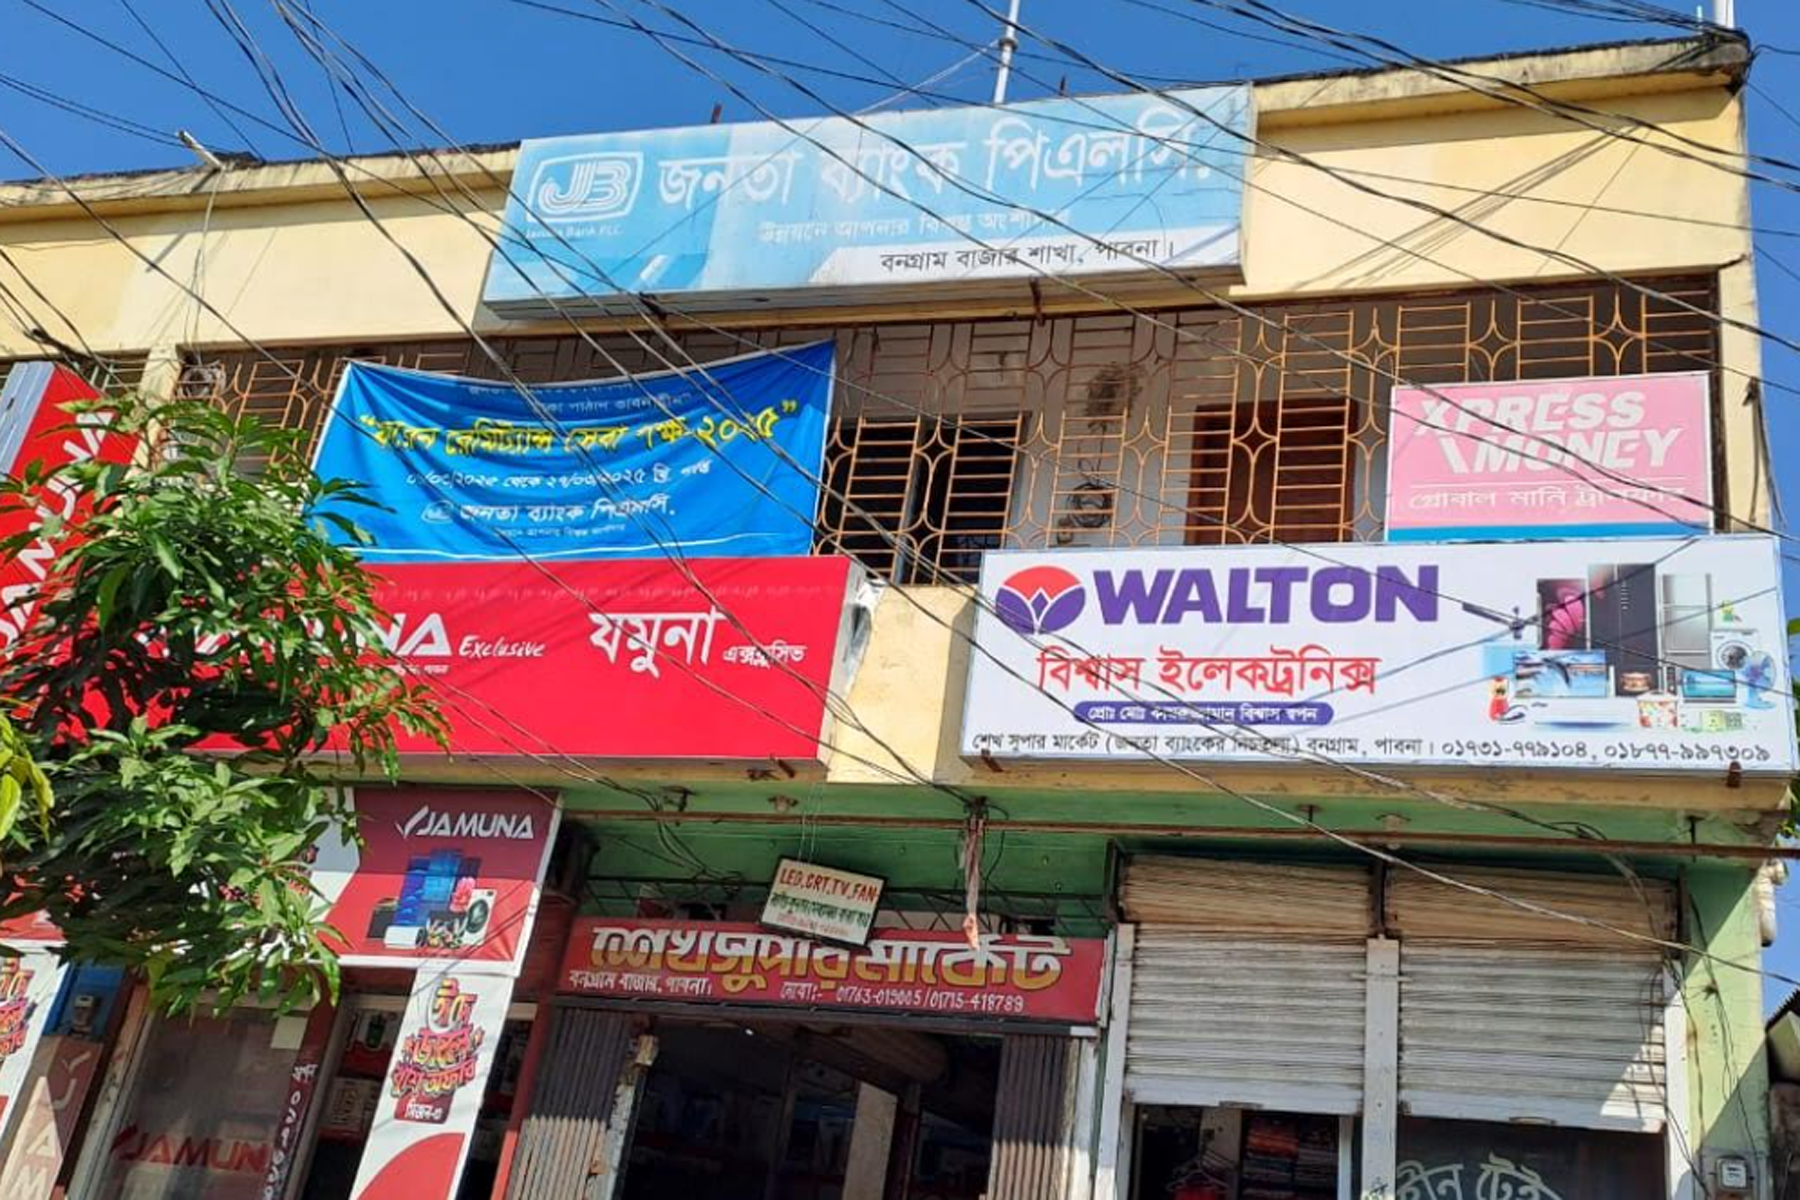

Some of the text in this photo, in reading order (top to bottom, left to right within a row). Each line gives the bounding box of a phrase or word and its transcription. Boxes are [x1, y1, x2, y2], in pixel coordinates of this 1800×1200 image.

[657, 150, 804, 211] জনতা
[880, 252, 949, 274] বনগ্রাম
[956, 247, 1020, 271] বাজার
[1473, 427, 1683, 473] MONEY
[1508, 484, 1567, 507] মানি
[1093, 565, 1439, 625] WALTON
[458, 633, 546, 657] Exclusive
[588, 605, 729, 677] যমুনা
[1036, 643, 1382, 697] বিশ্বাস ইলেকট্রনিক্স
[415, 813, 535, 840] JAMUNA
